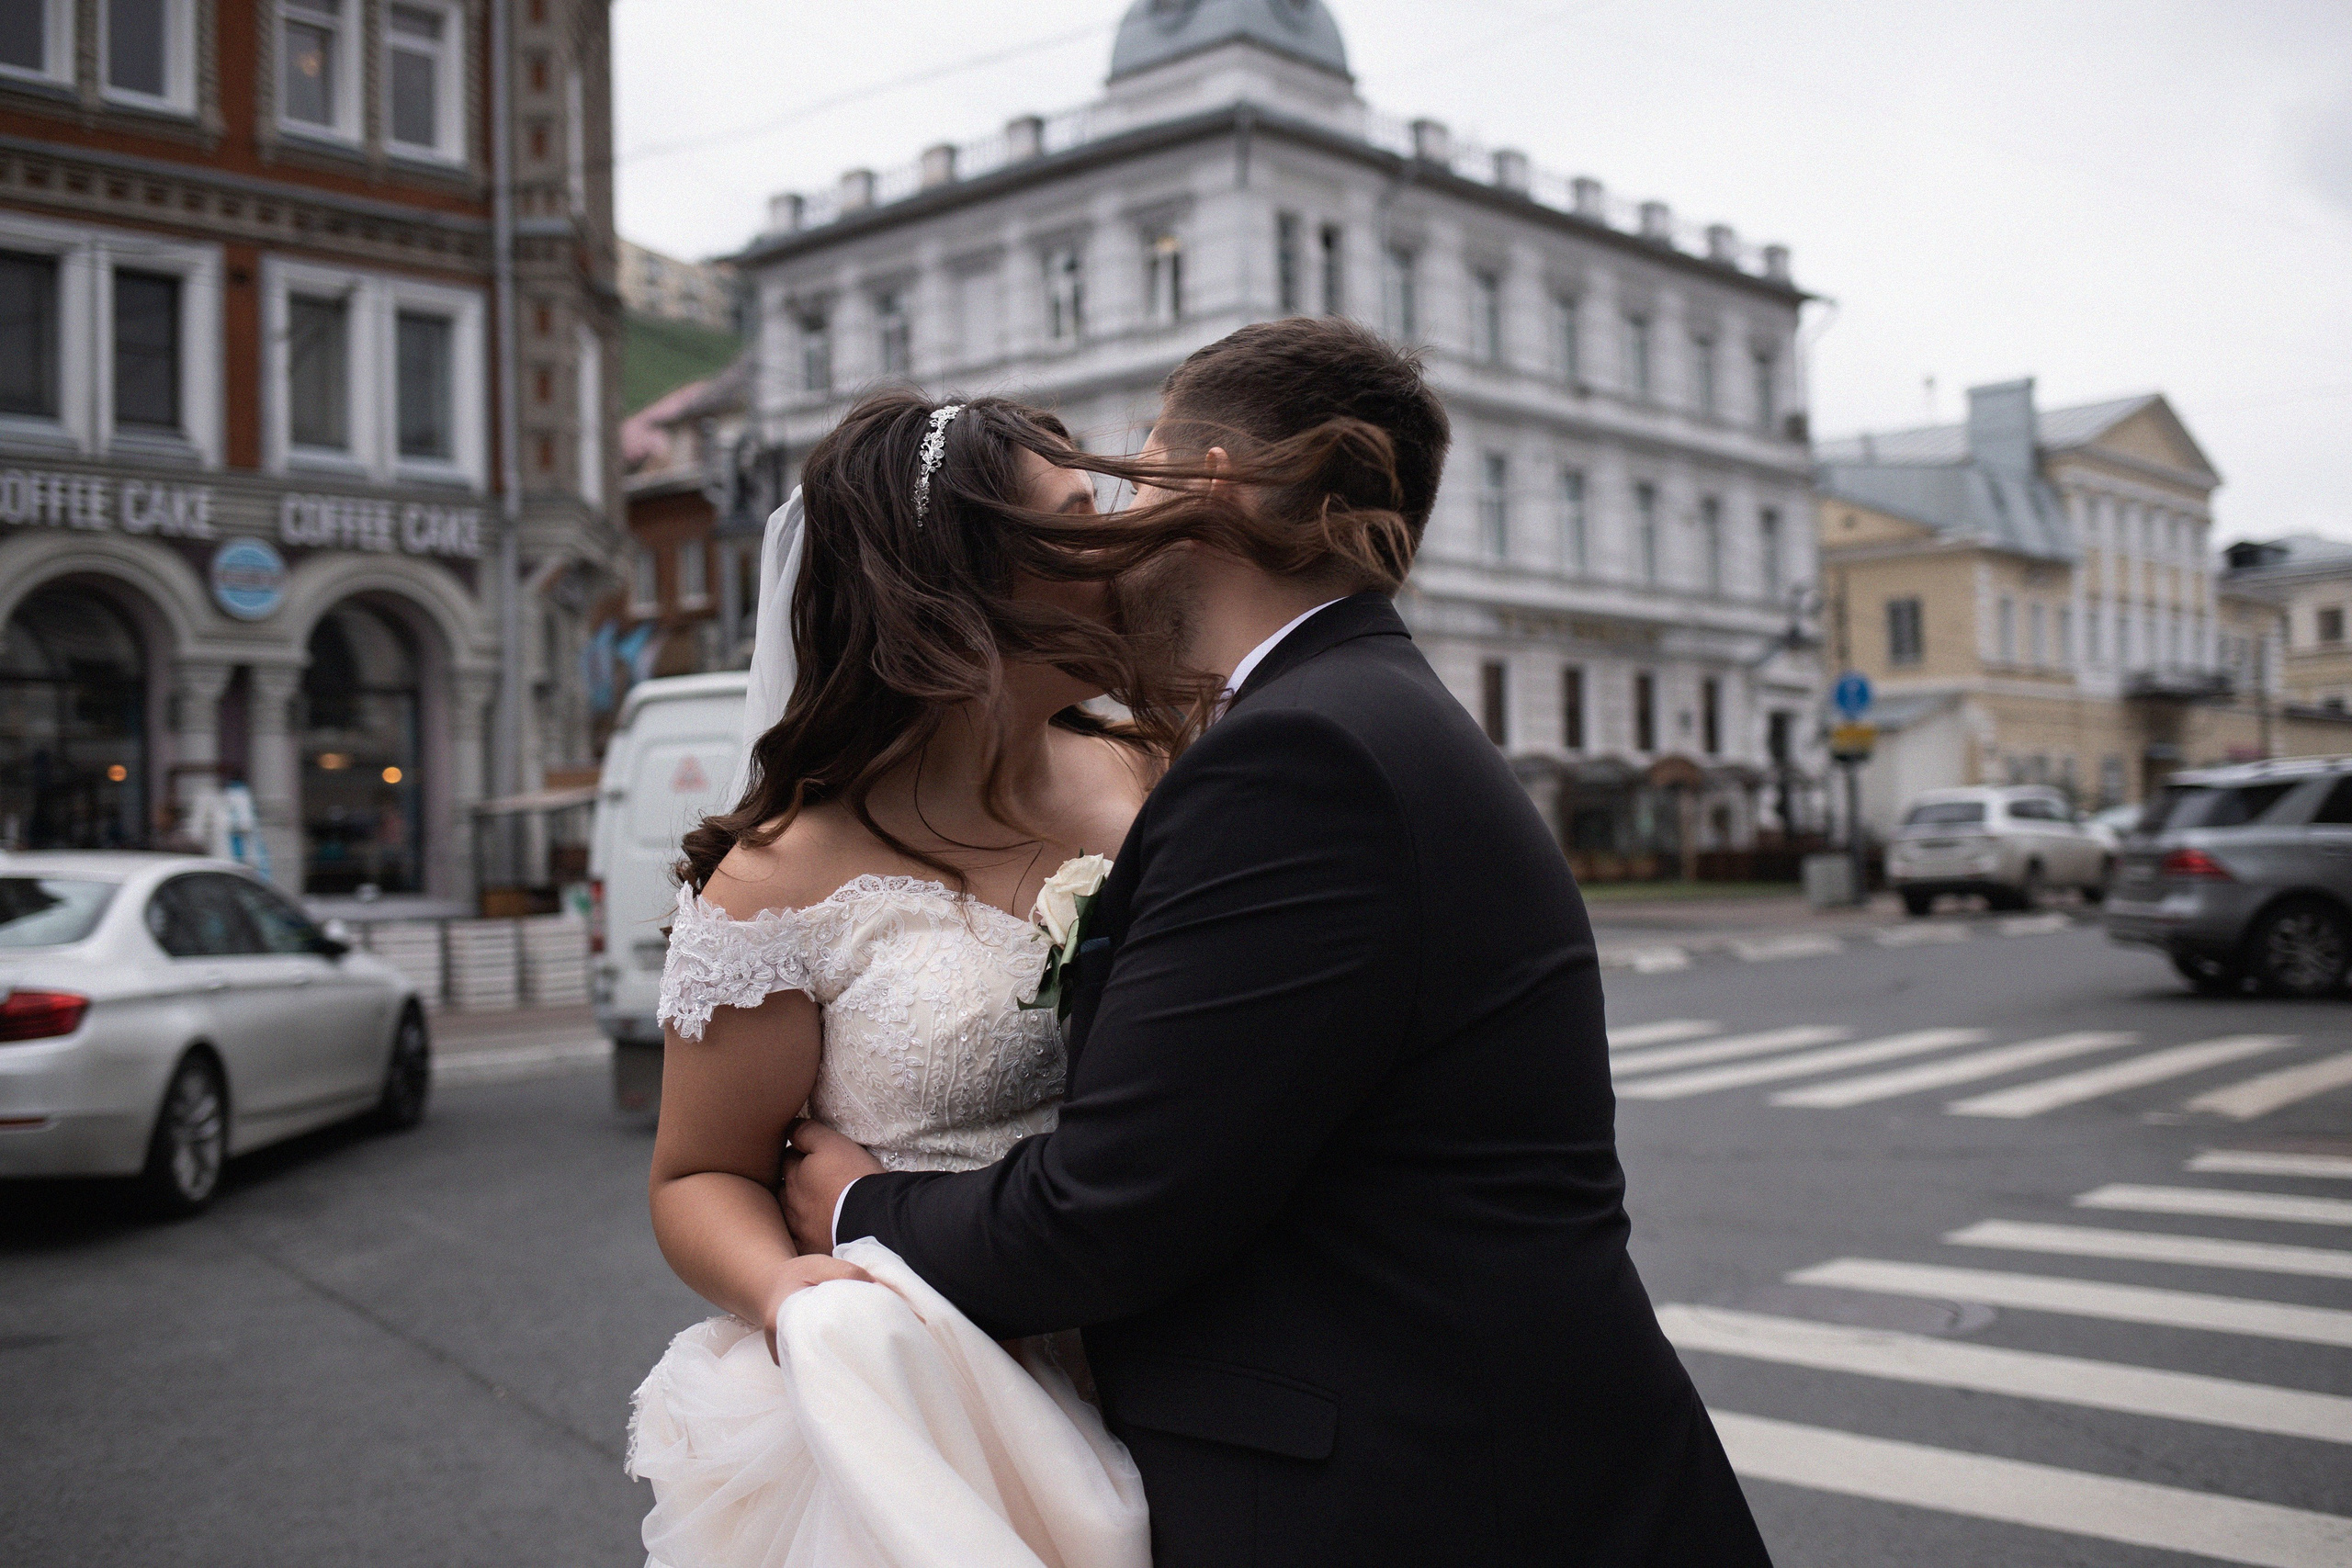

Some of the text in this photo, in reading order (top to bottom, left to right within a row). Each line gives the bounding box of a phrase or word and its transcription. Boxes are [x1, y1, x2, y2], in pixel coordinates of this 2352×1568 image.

[0, 469, 216, 539] OFFEE CAKE
[280, 493, 481, 557] COFFEE CAKE
